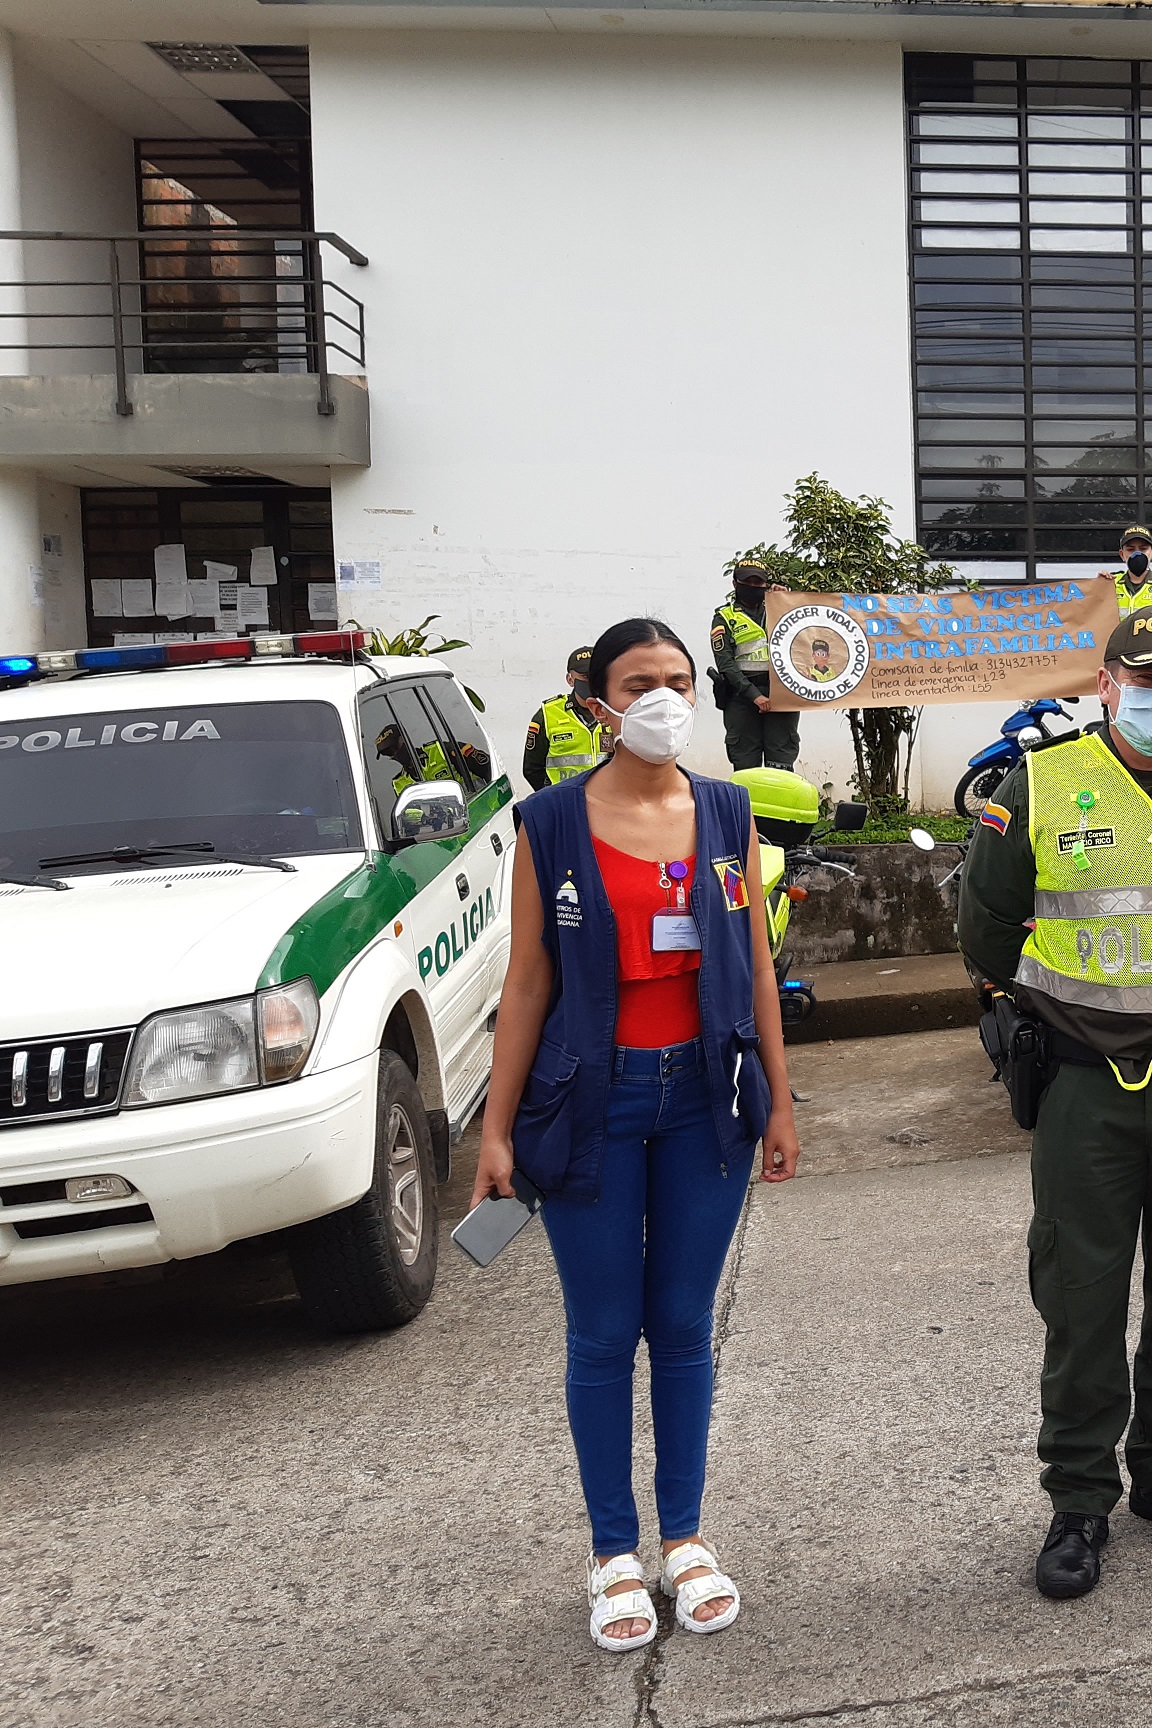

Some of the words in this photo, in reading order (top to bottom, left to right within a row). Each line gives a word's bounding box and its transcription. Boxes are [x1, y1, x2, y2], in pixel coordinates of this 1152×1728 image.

[1124, 527, 1150, 537] POLICIA
[841, 593, 880, 613] NO
[885, 596, 954, 615] SEAS
[969, 582, 1086, 610] VICTIMA
[771, 607, 820, 647] PROTEGER
[826, 608, 858, 634] VIDAS
[865, 617, 902, 636] DE
[916, 610, 1065, 636] VIOLENCIA
[873, 630, 1097, 660] INTRAFAMILIAR
[771, 651, 837, 700] COMPROMISO
[836, 679, 854, 694] DE
[851, 639, 866, 679] TODOS
[929, 660, 944, 674] de
[986, 655, 1058, 671] 3134327757
[904, 676, 917, 688] de
[1095, 836, 1112, 845] RICO
[418, 887, 496, 988] POLICIA
